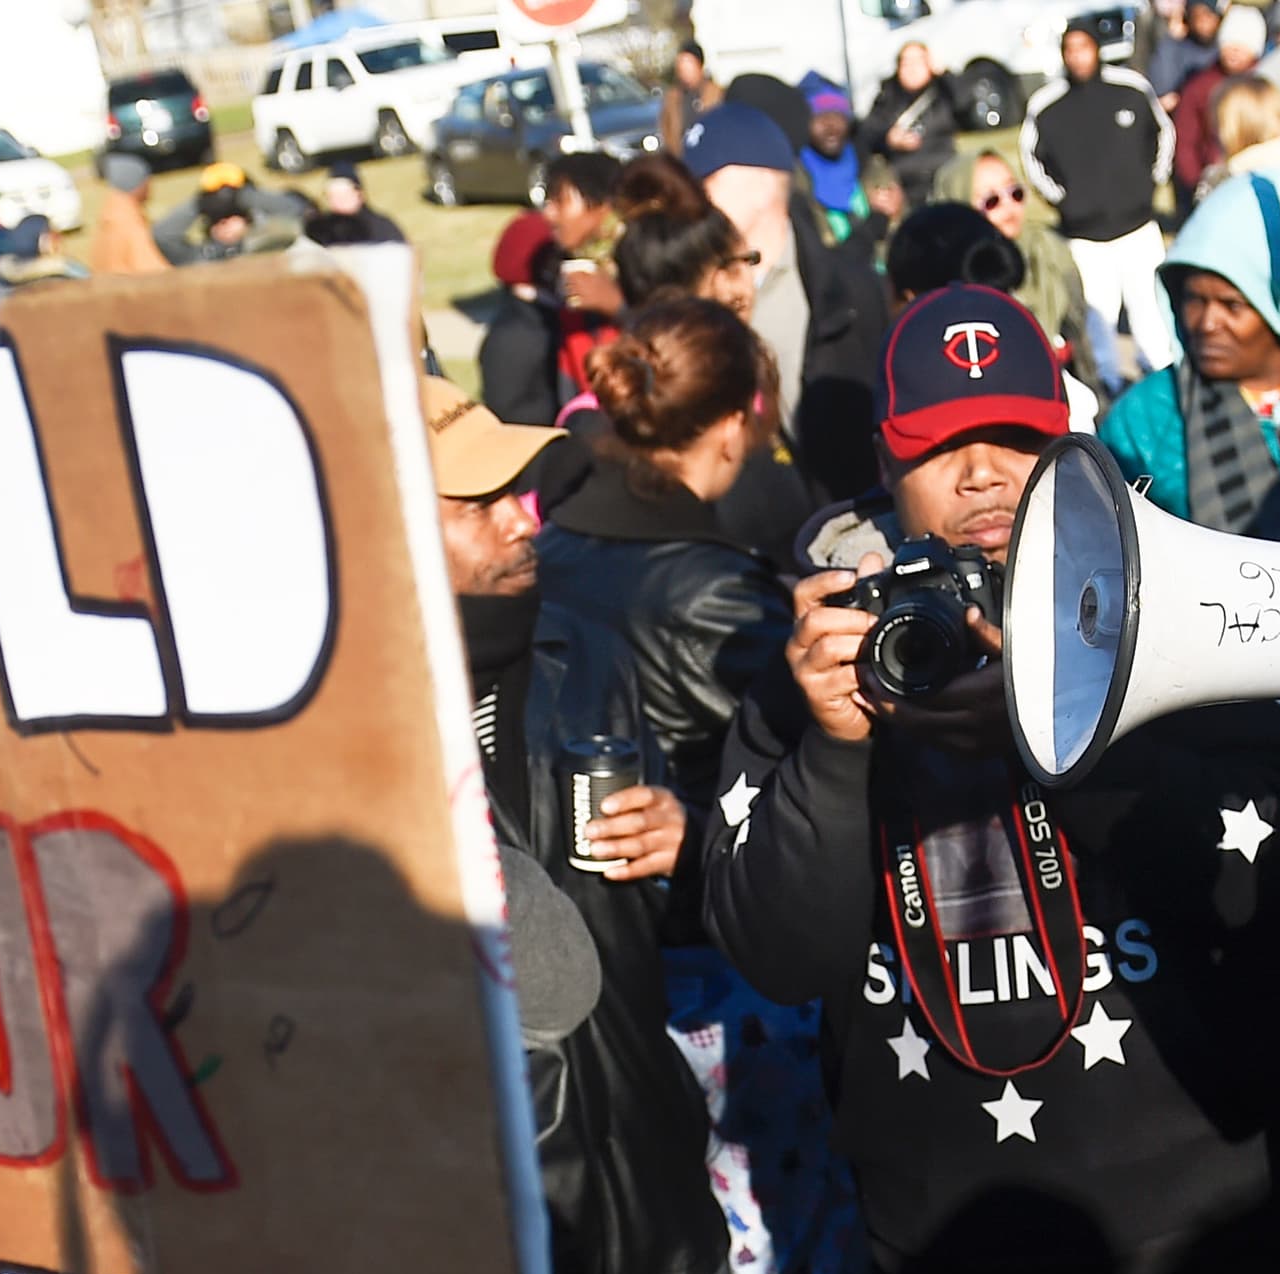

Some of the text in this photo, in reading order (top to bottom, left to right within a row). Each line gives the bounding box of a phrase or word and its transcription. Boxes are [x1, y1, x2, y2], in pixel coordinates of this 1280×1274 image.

[1022, 782, 1063, 890] EOS 70D
[895, 844, 927, 929] Canon
[862, 917, 1159, 1006] SLINGS
